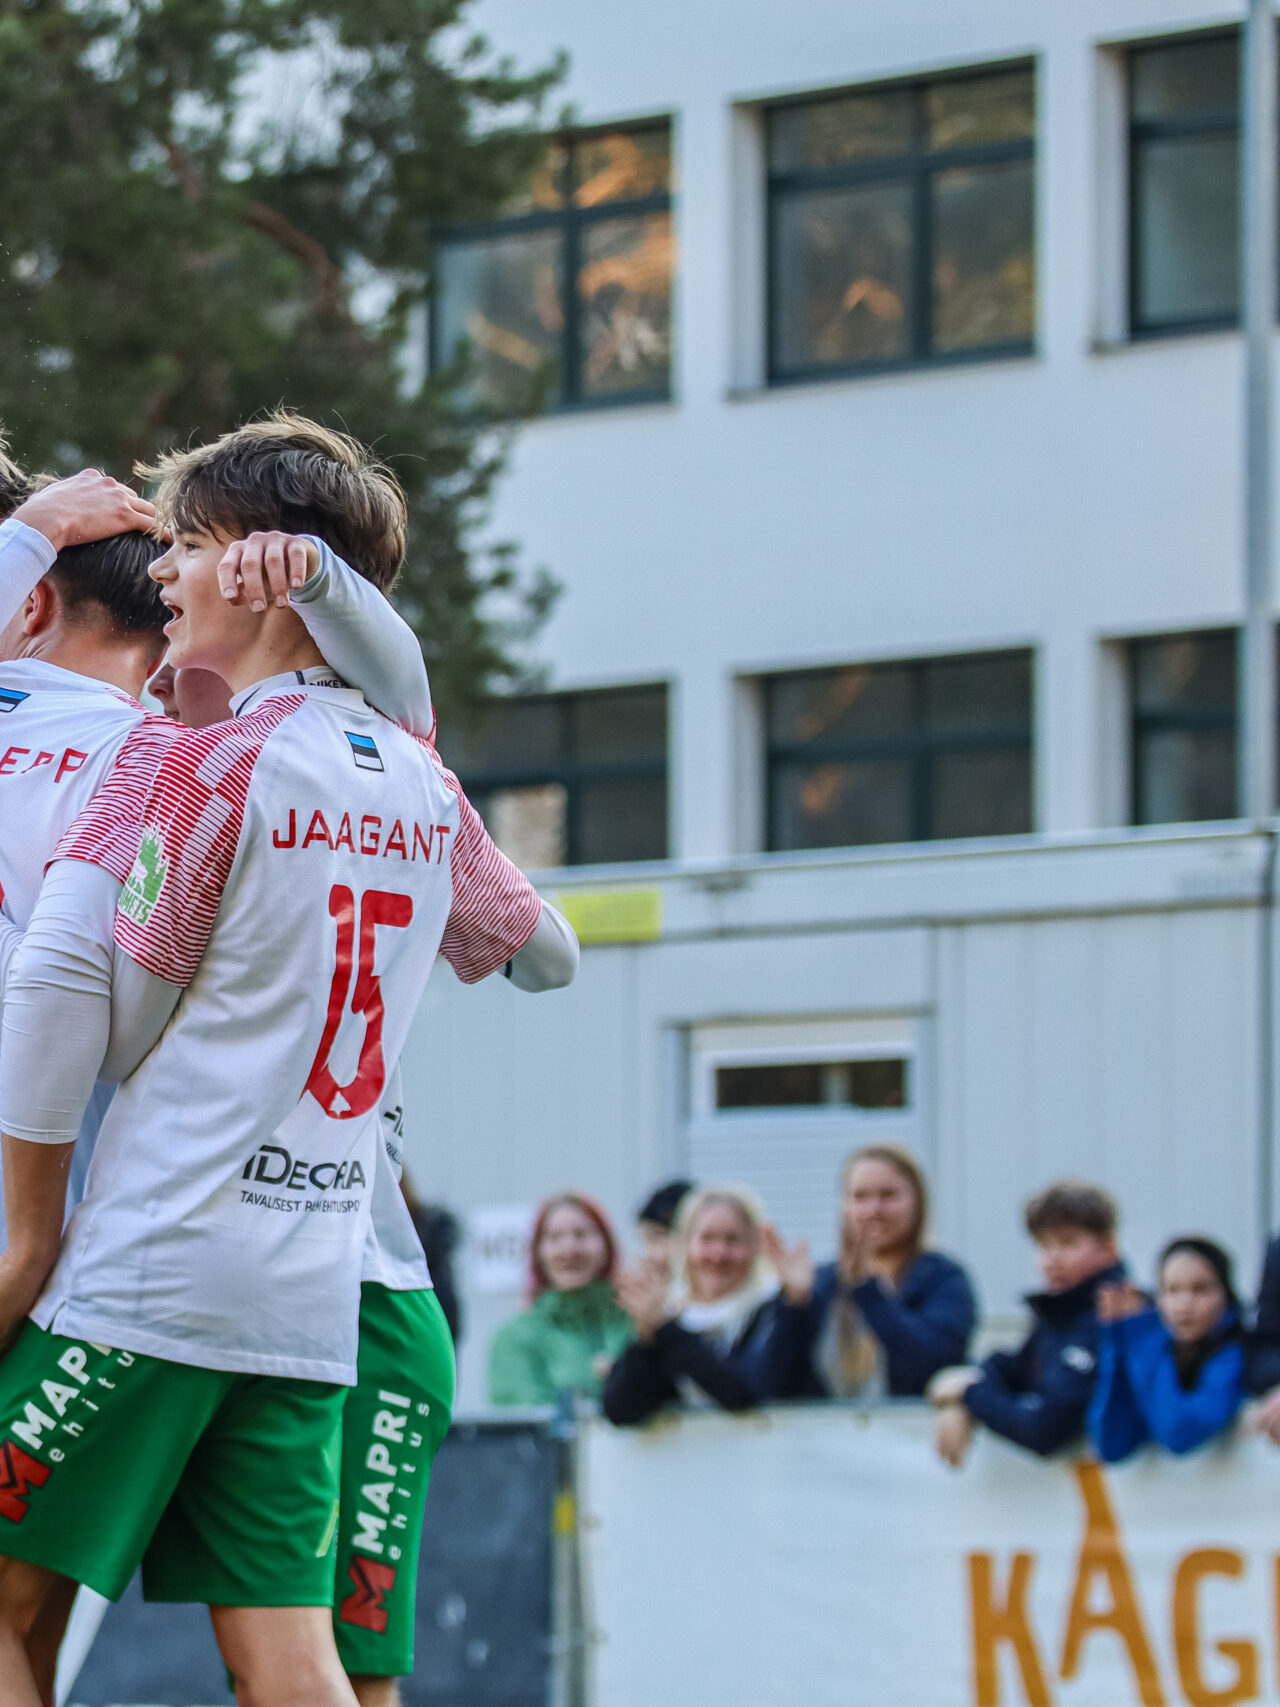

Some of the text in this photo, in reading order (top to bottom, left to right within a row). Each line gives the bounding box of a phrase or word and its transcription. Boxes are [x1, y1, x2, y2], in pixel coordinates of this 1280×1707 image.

[272, 808, 451, 864] JAAGANT
[299, 884, 413, 1120] 15
[241, 1190, 300, 1212] TAVALISEST
[352, 1389, 412, 1555] MAPRI
[388, 1402, 431, 1561] ehitus
